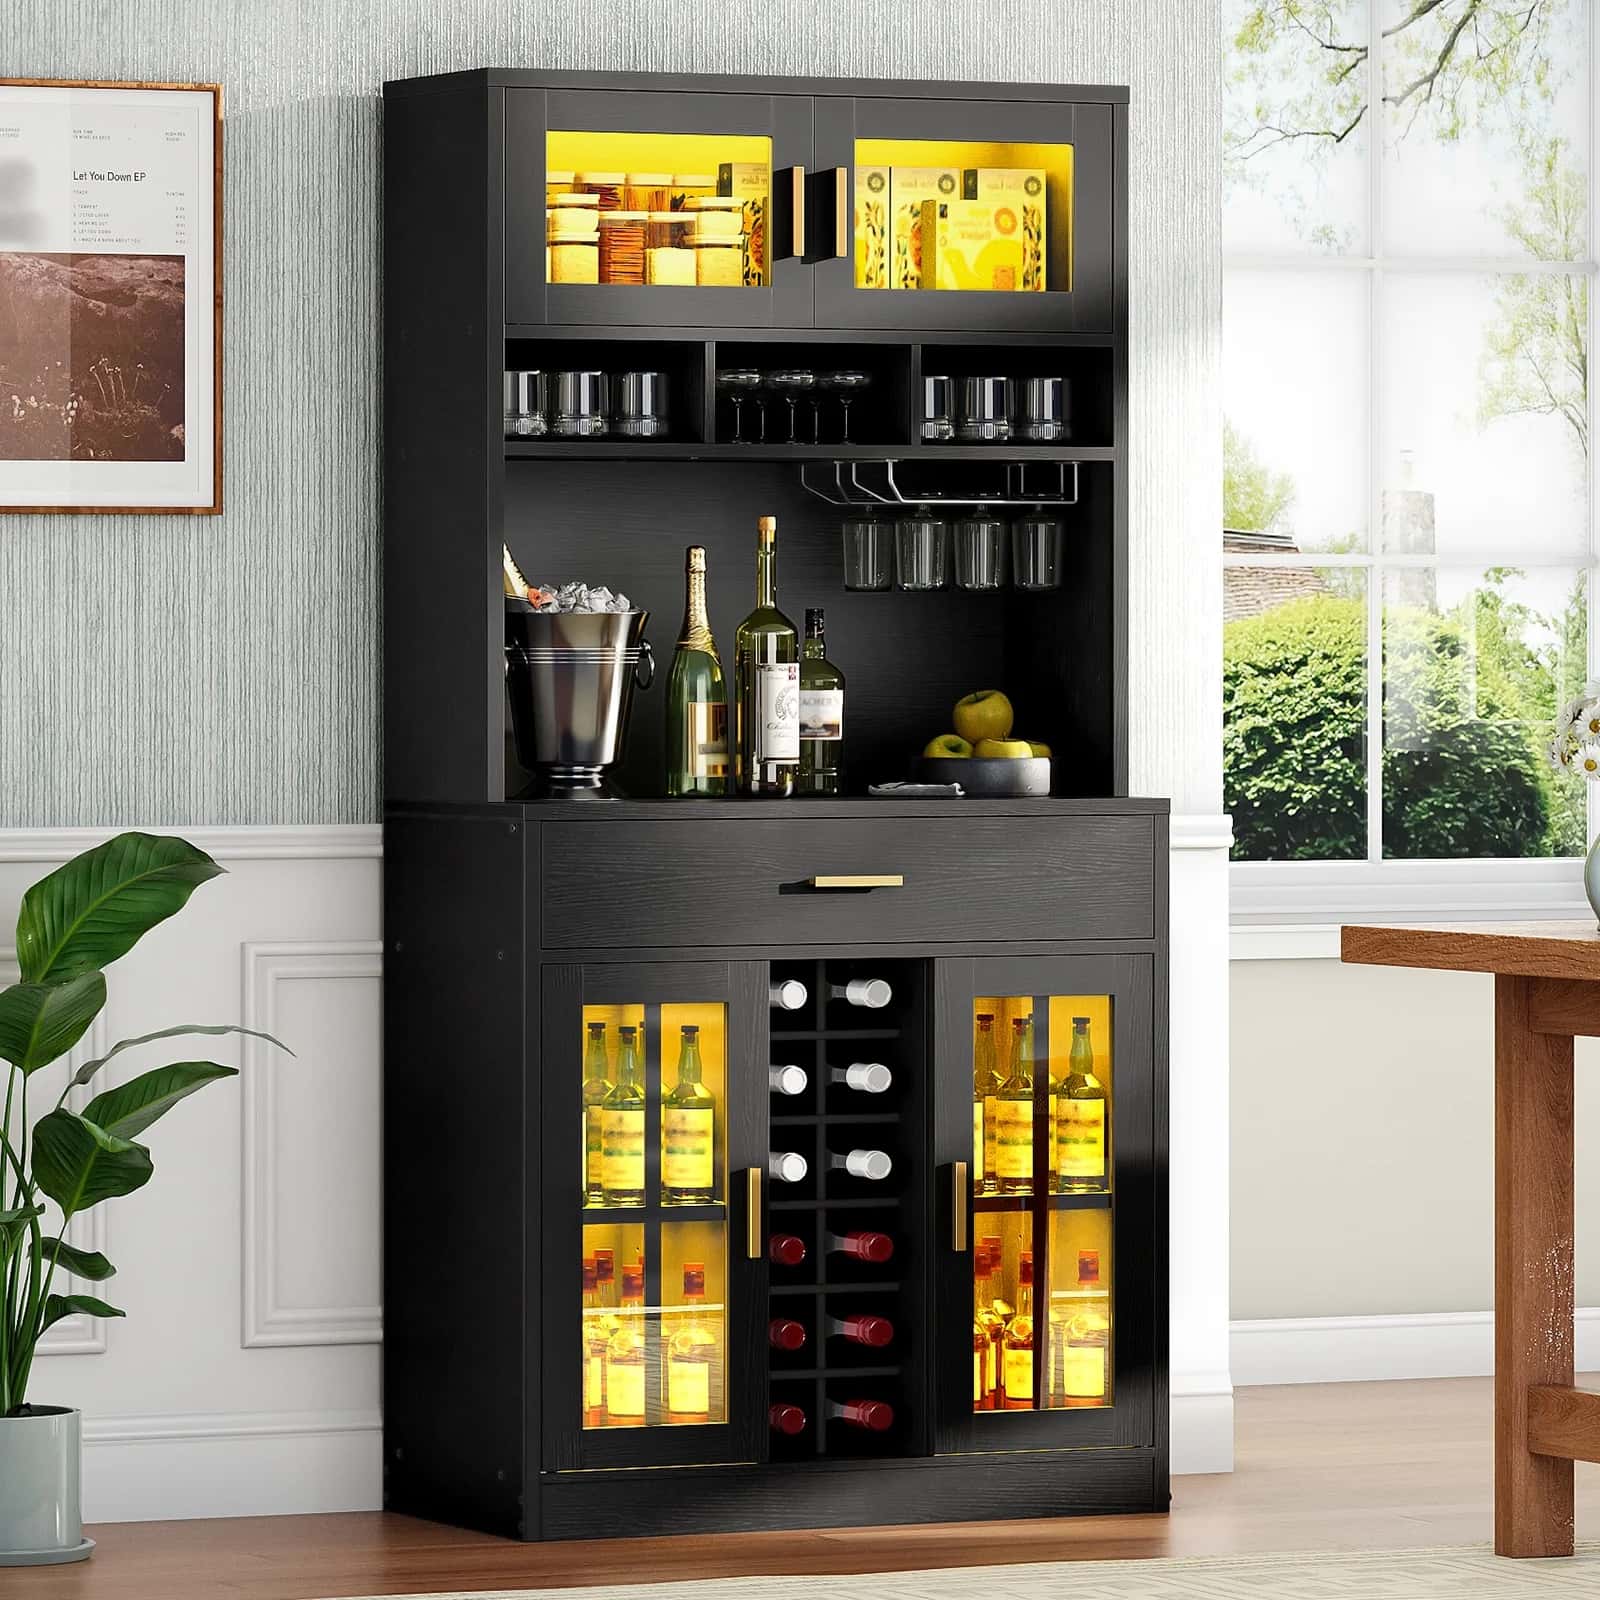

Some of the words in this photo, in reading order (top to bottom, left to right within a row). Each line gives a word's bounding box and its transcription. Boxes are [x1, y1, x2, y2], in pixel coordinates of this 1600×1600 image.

[73, 171, 87, 181] Let
[89, 171, 105, 182] You
[107, 172, 132, 182] Down
[134, 172, 146, 182] EP
